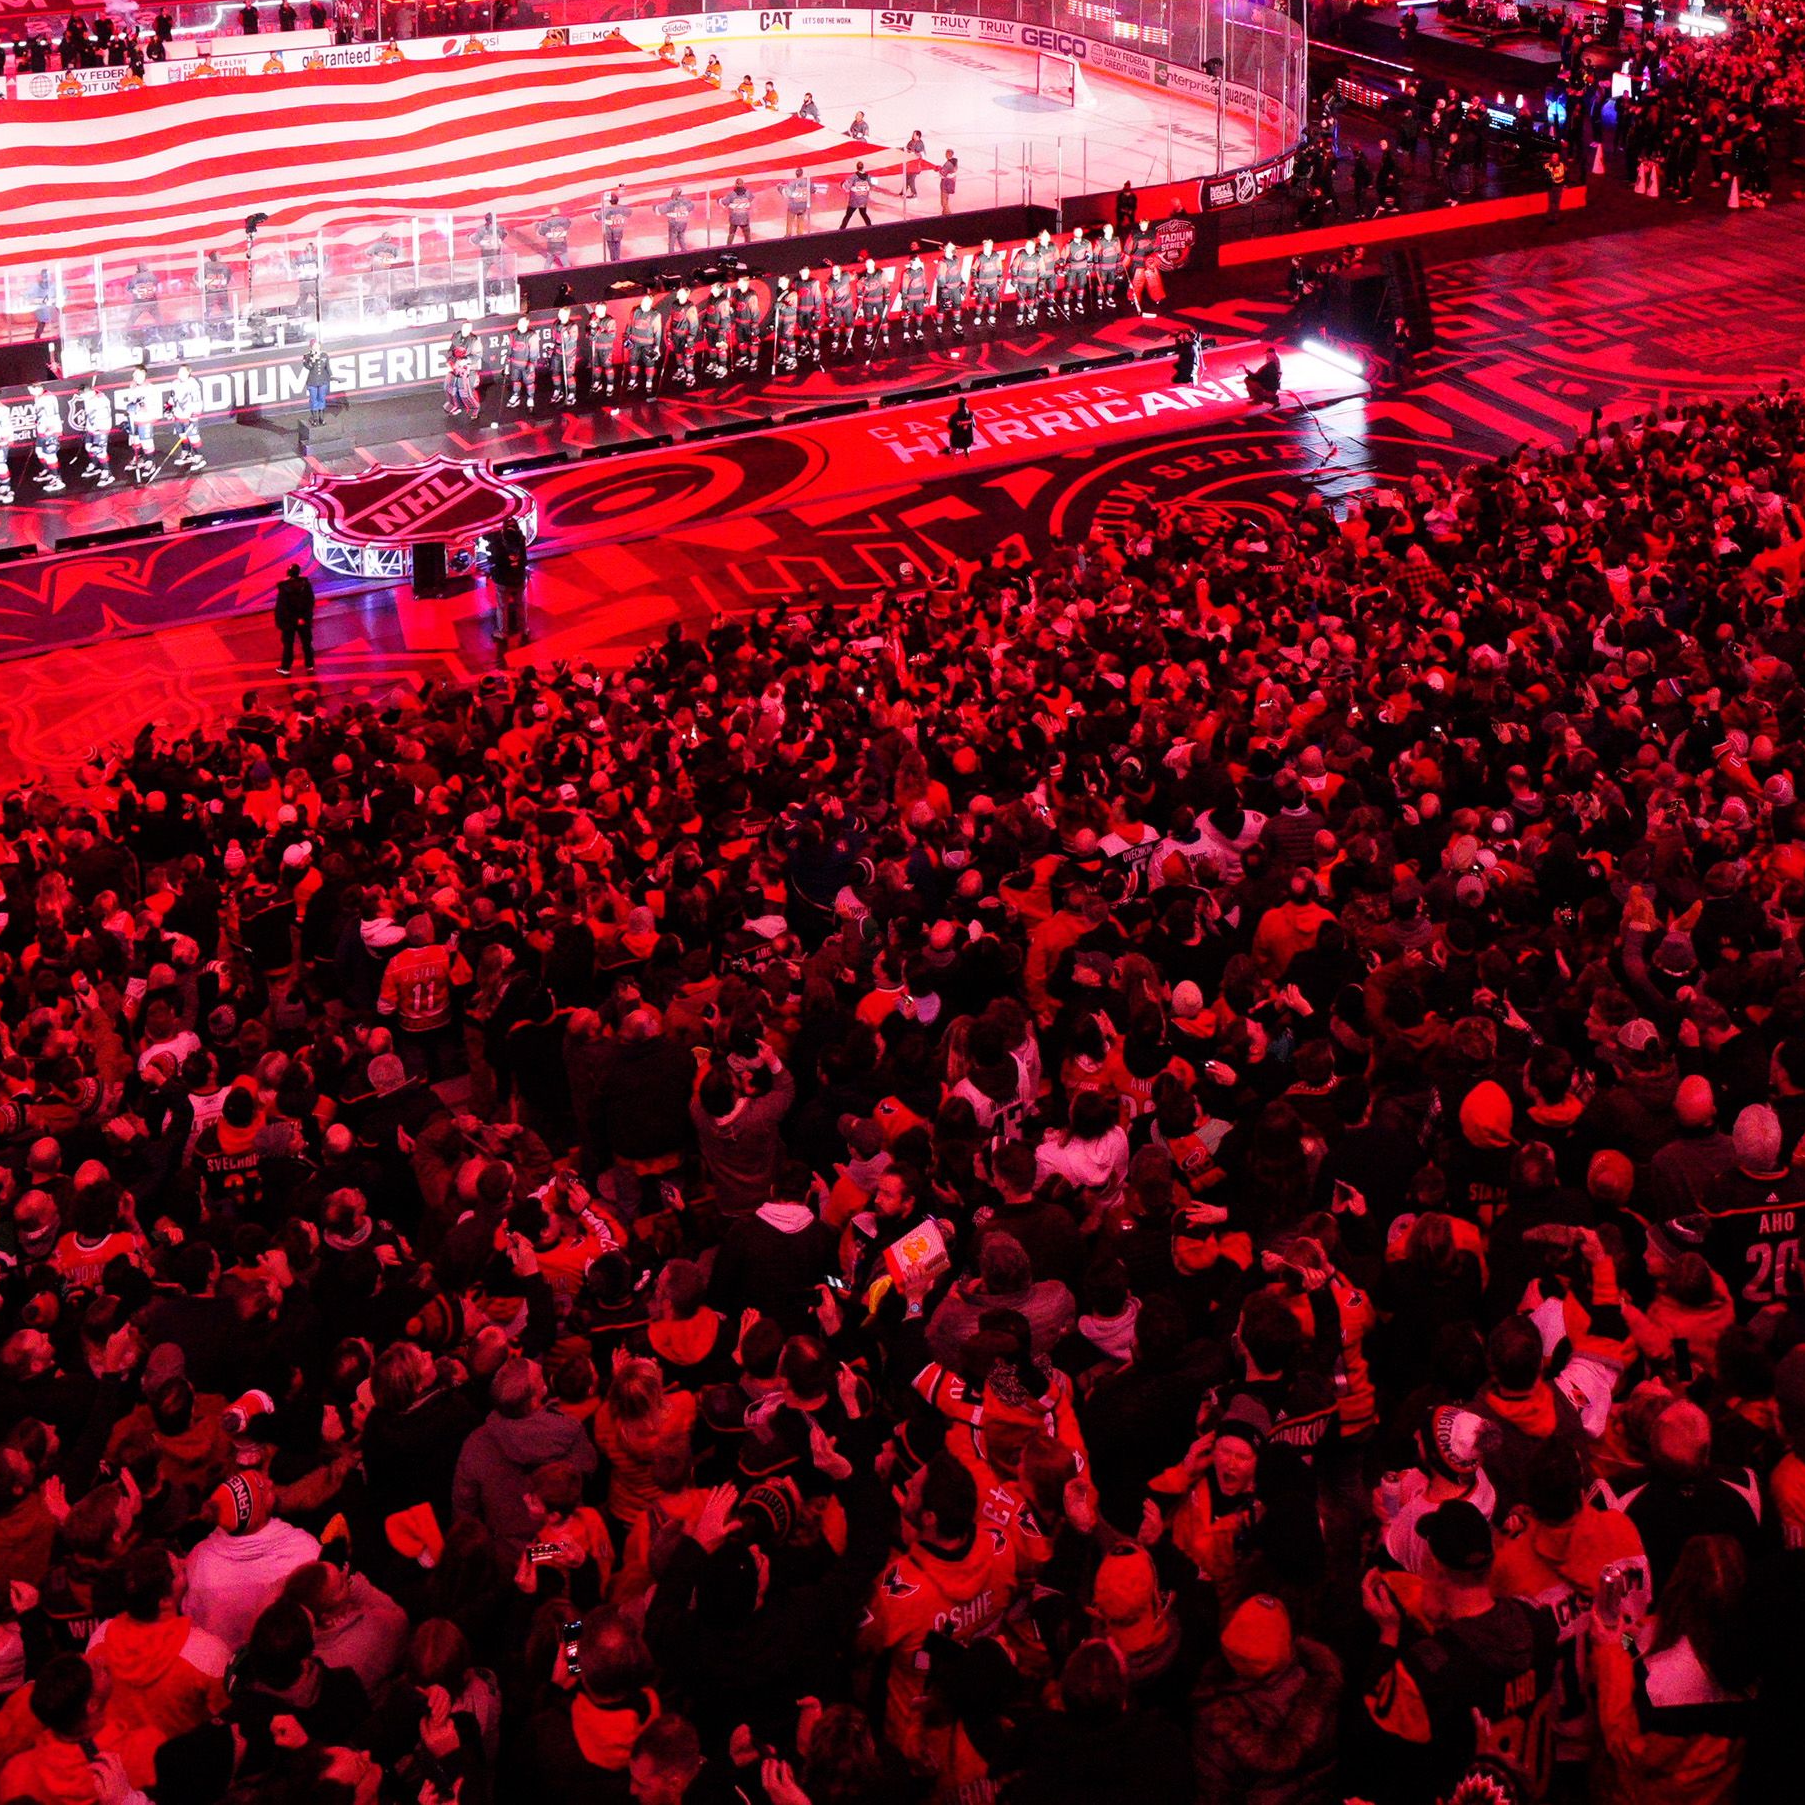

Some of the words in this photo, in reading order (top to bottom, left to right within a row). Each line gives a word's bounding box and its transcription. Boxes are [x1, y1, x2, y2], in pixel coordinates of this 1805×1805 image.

[661, 22, 692, 34] Glidden
[706, 14, 727, 33] PPG
[760, 11, 792, 32] CAT
[826, 17, 835, 25] THE
[836, 17, 851, 25] WORK
[880, 12, 914, 27] SN
[932, 15, 970, 29] TRULY
[979, 20, 1014, 35] TRULY
[1021, 27, 1087, 59] GEICO
[213, 59, 247, 68] HEALTHY
[1104, 46, 1123, 60] NAVY
[1123, 52, 1150, 70] FEDERAL
[89, 69, 124, 81] FEDER
[1104, 58, 1127, 75] CREDIT
[1127, 64, 1150, 81] UNION
[1156, 67, 1219, 95] enterprise
[1158, 229, 1193, 244] TADIUM
[1160, 242, 1186, 251] SERIES
[330, 346, 450, 396] SERIE
[868, 384, 1123, 442] CAOLINA
[883, 367, 1251, 466] HRRICANE
[371, 476, 465, 534] NHL
[1122, 843, 1155, 864] OVECHKIN
[411, 985, 434, 1012] 11
[1758, 1210, 1795, 1236] AHO
[934, 1591, 995, 1632] OSHIE
